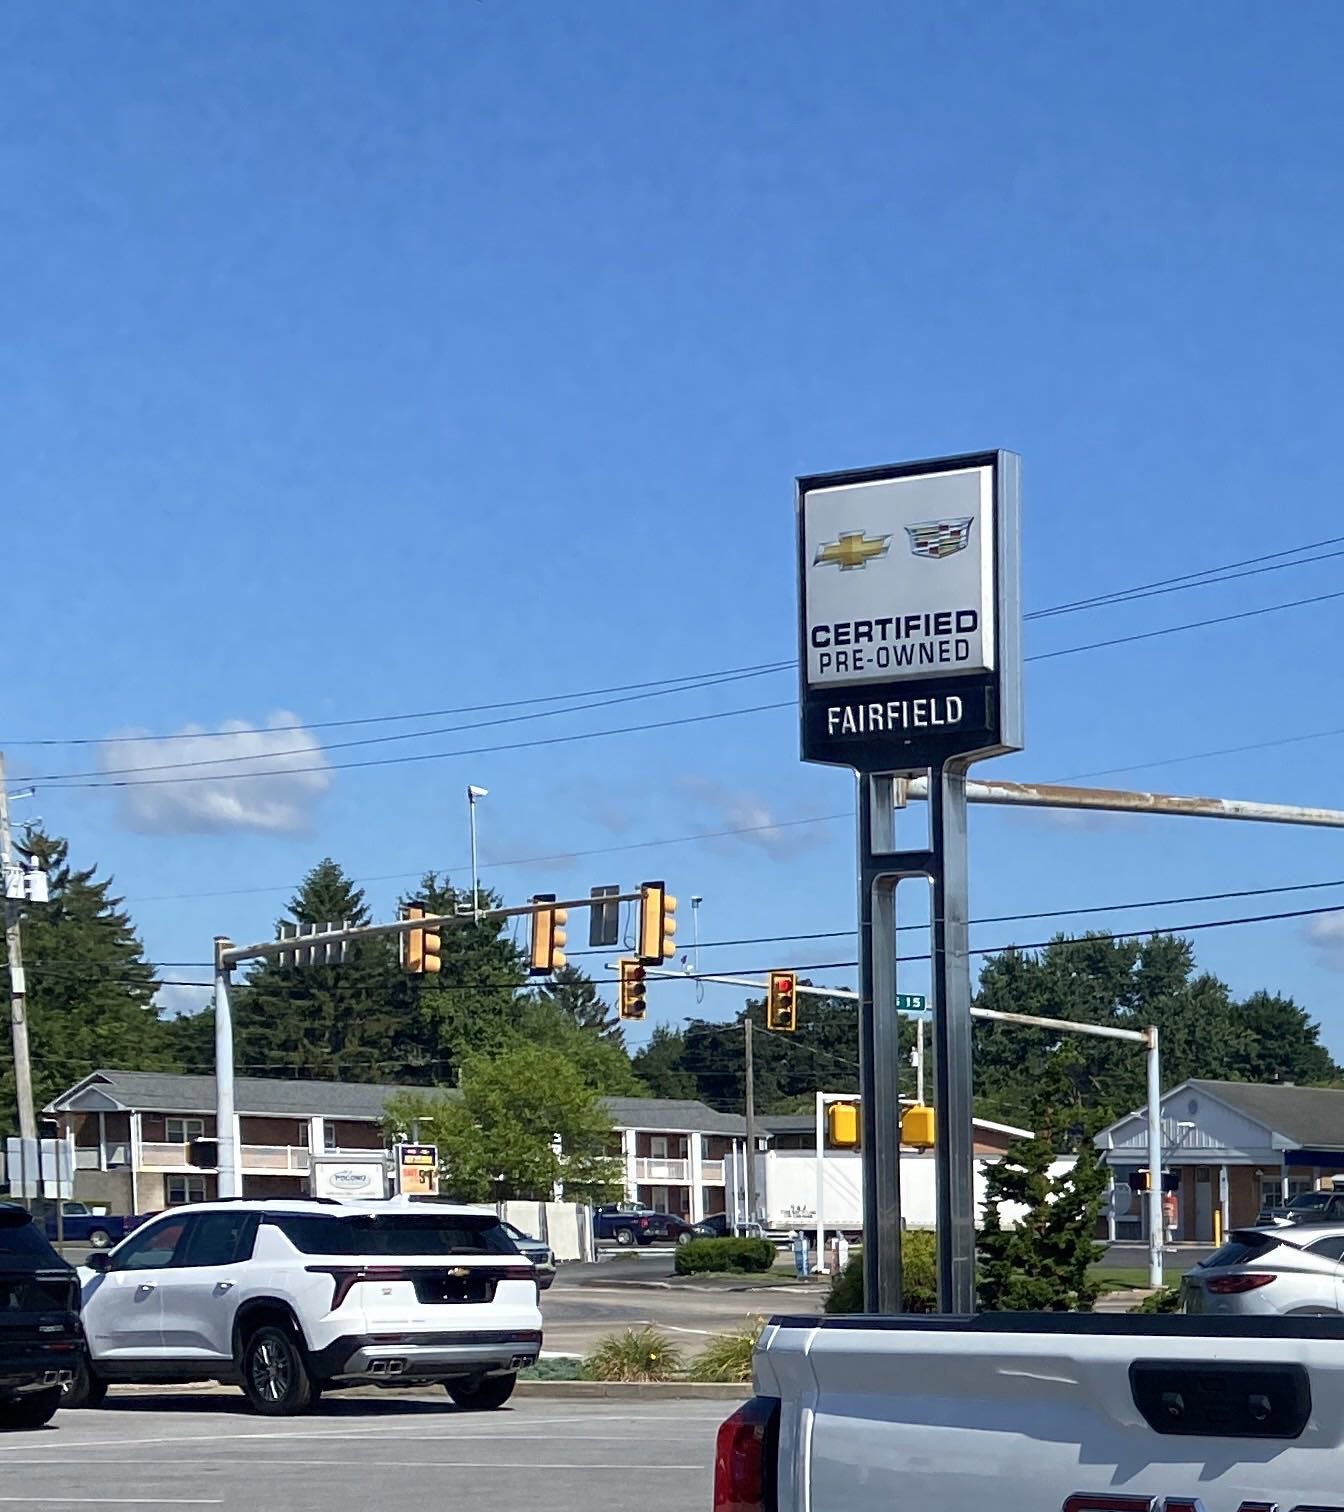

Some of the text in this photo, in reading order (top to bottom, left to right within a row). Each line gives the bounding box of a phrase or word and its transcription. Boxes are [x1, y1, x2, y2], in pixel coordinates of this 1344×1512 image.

[812, 609, 978, 649] CERTIFIED
[819, 639, 970, 674] PRE-OWNED
[827, 696, 963, 735] FAIRFIELD
[906, 997, 920, 1008] 15
